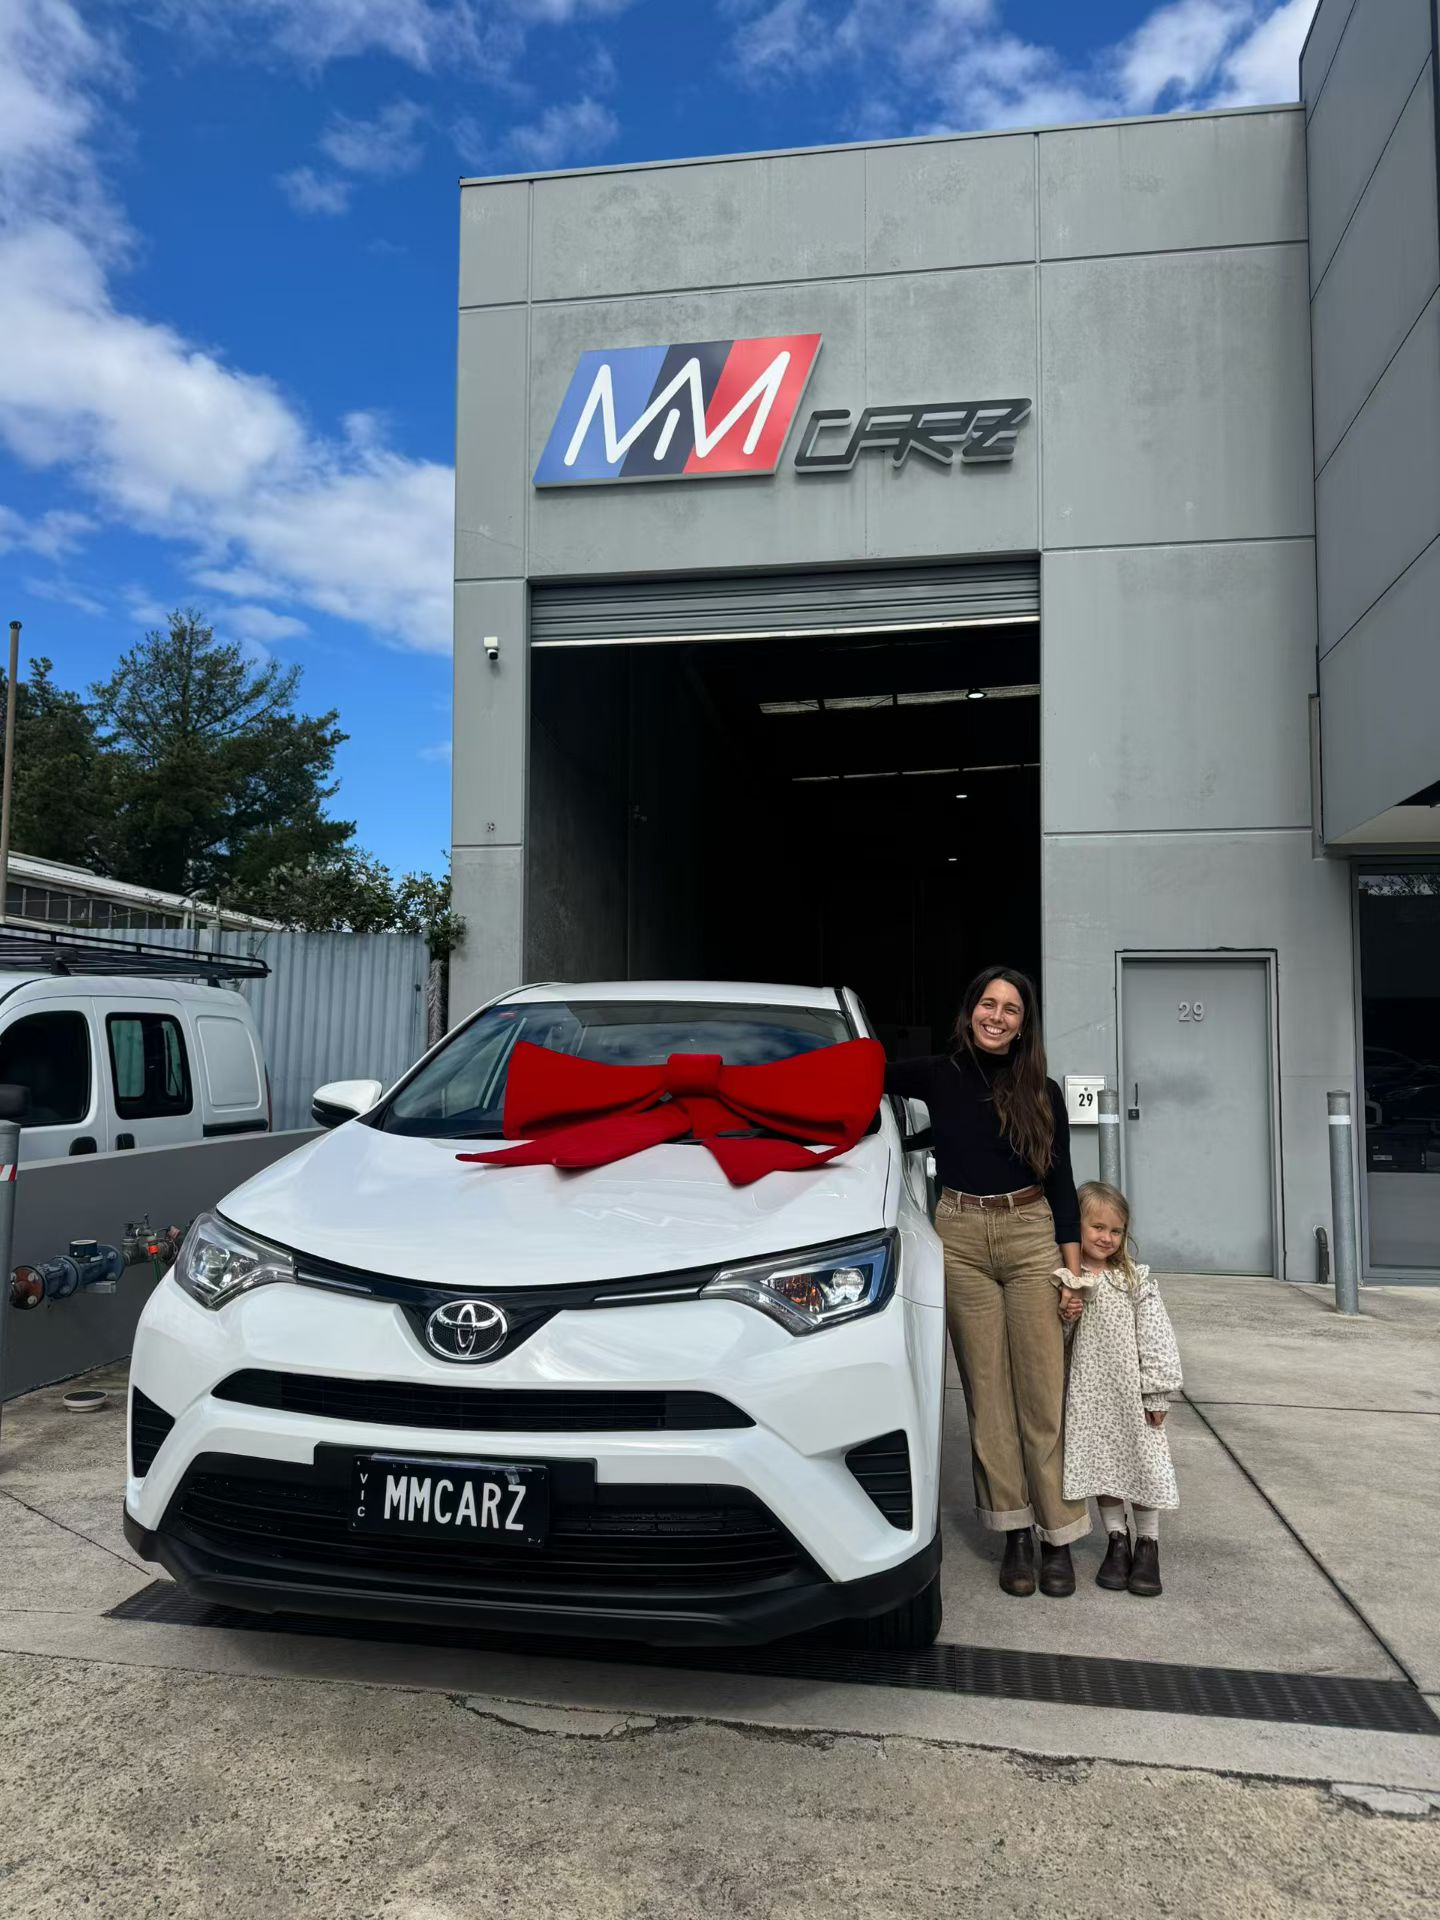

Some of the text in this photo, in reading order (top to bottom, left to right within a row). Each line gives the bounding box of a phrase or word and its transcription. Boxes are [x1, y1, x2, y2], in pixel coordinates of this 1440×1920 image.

[794, 397, 1033, 472] CARZ
[1178, 1002, 1205, 1022] 29
[1078, 1093, 1094, 1107] 29
[357, 1473, 369, 1517] VIC
[383, 1474, 527, 1531] MMCARZ
